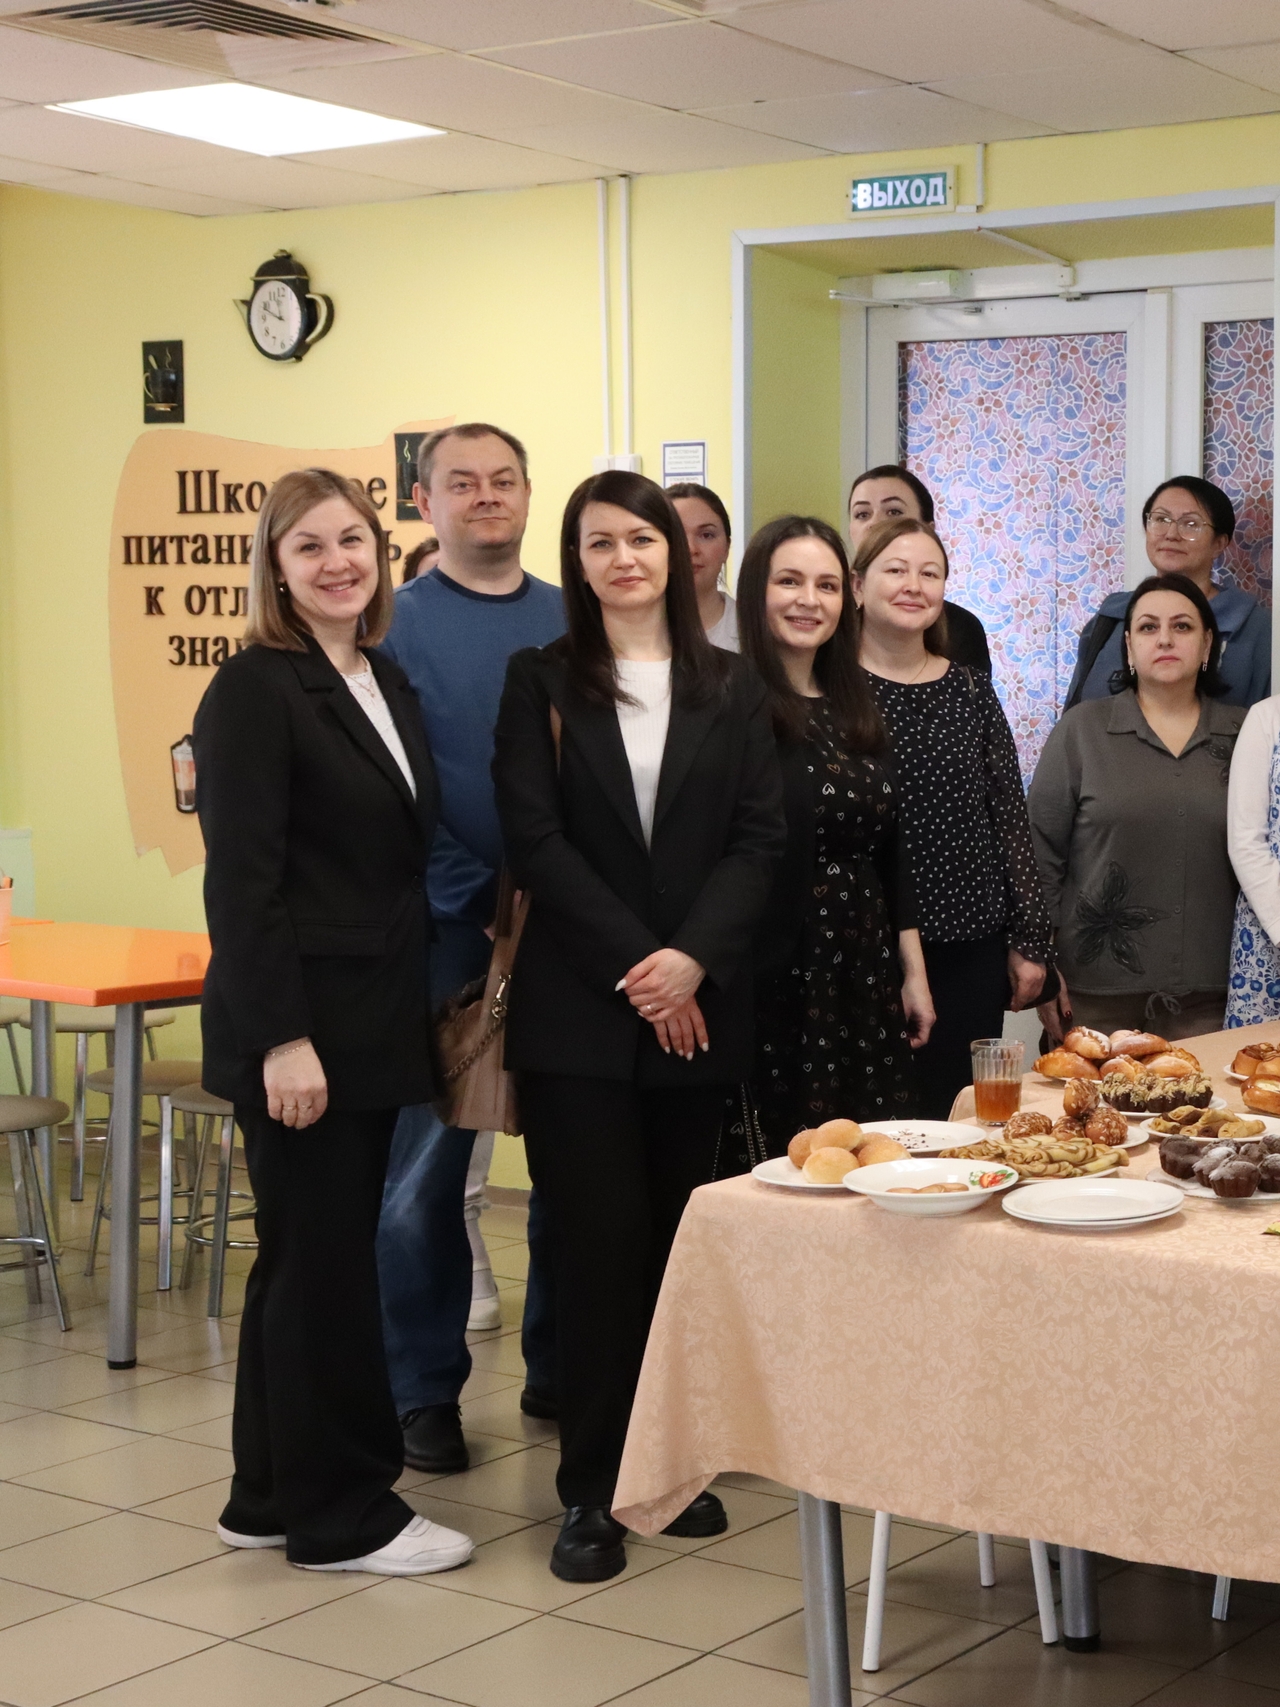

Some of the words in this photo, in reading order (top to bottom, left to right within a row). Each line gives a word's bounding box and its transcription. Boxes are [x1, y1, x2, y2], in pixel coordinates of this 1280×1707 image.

[857, 177, 945, 209] ВЫХОД
[121, 533, 253, 565] питани
[143, 585, 166, 616] к
[184, 584, 249, 617] отл
